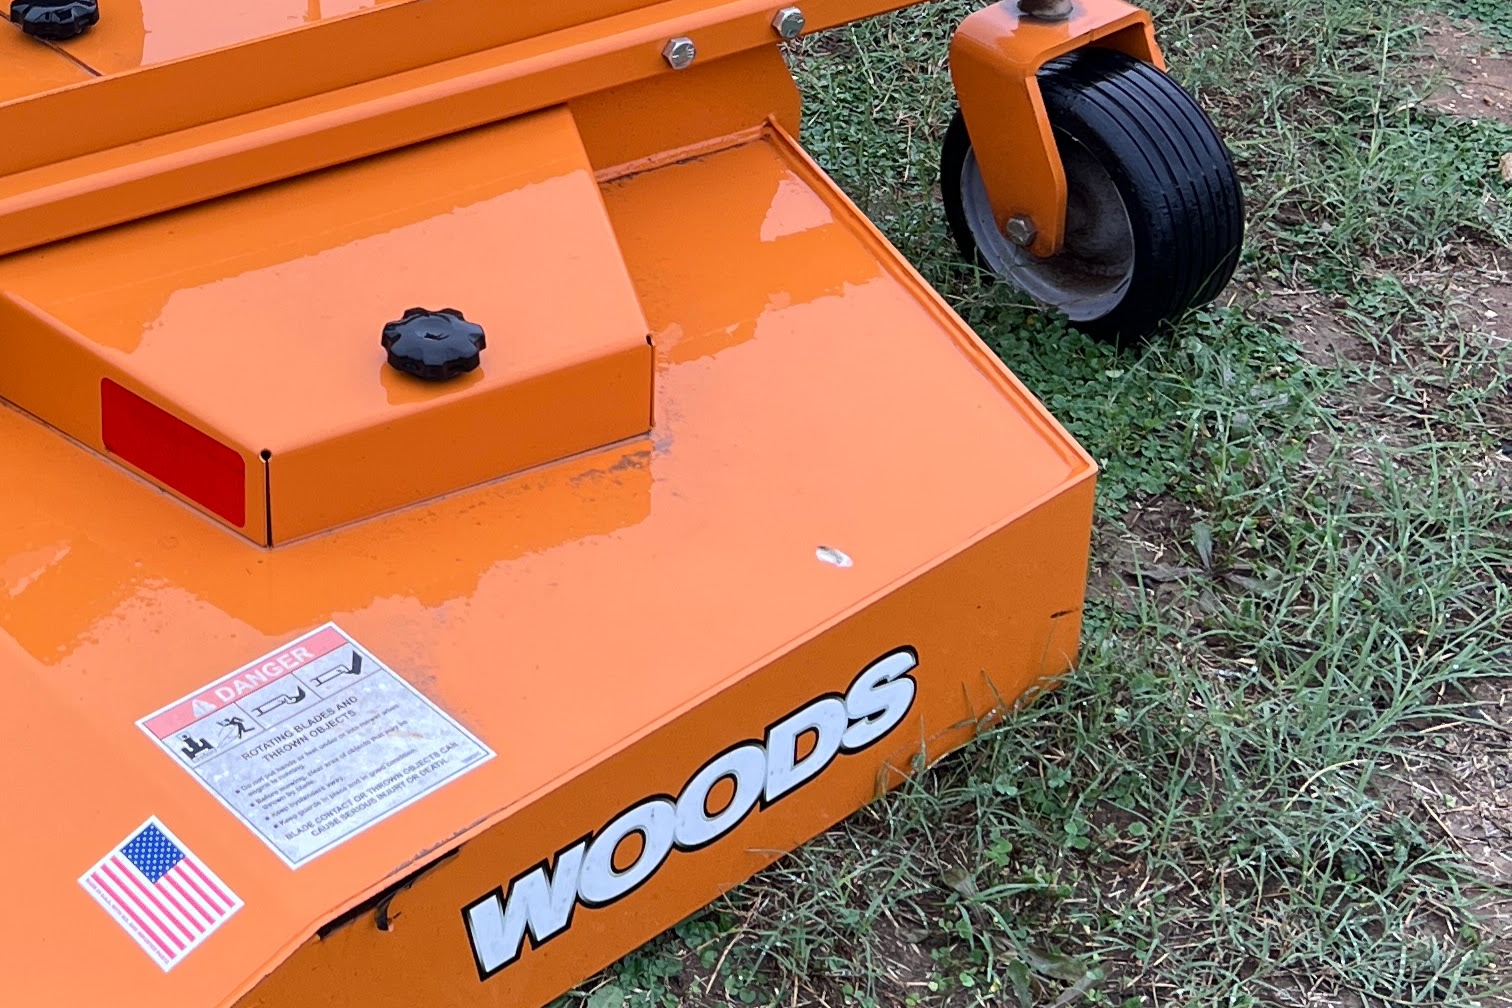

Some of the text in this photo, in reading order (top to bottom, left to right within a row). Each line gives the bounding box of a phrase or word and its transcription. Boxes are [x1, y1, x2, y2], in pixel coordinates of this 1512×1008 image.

[212, 645, 315, 703] DANGER
[240, 695, 359, 760] ROTATING BLADES AND
[261, 709, 357, 762] THROWN OBJECTS
[283, 820, 315, 840] BLADE
[313, 799, 354, 823] CONTACT
[351, 791, 368, 802] OR
[365, 771, 404, 795] THROWN
[400, 750, 442, 775] OBJECTS
[438, 740, 460, 754] CAN
[309, 817, 342, 837] CAUSE
[338, 796, 378, 821] SERIOUS
[374, 780, 408, 800] INJURY
[404, 773, 421, 784] OR
[461, 645, 919, 981] WOODS
